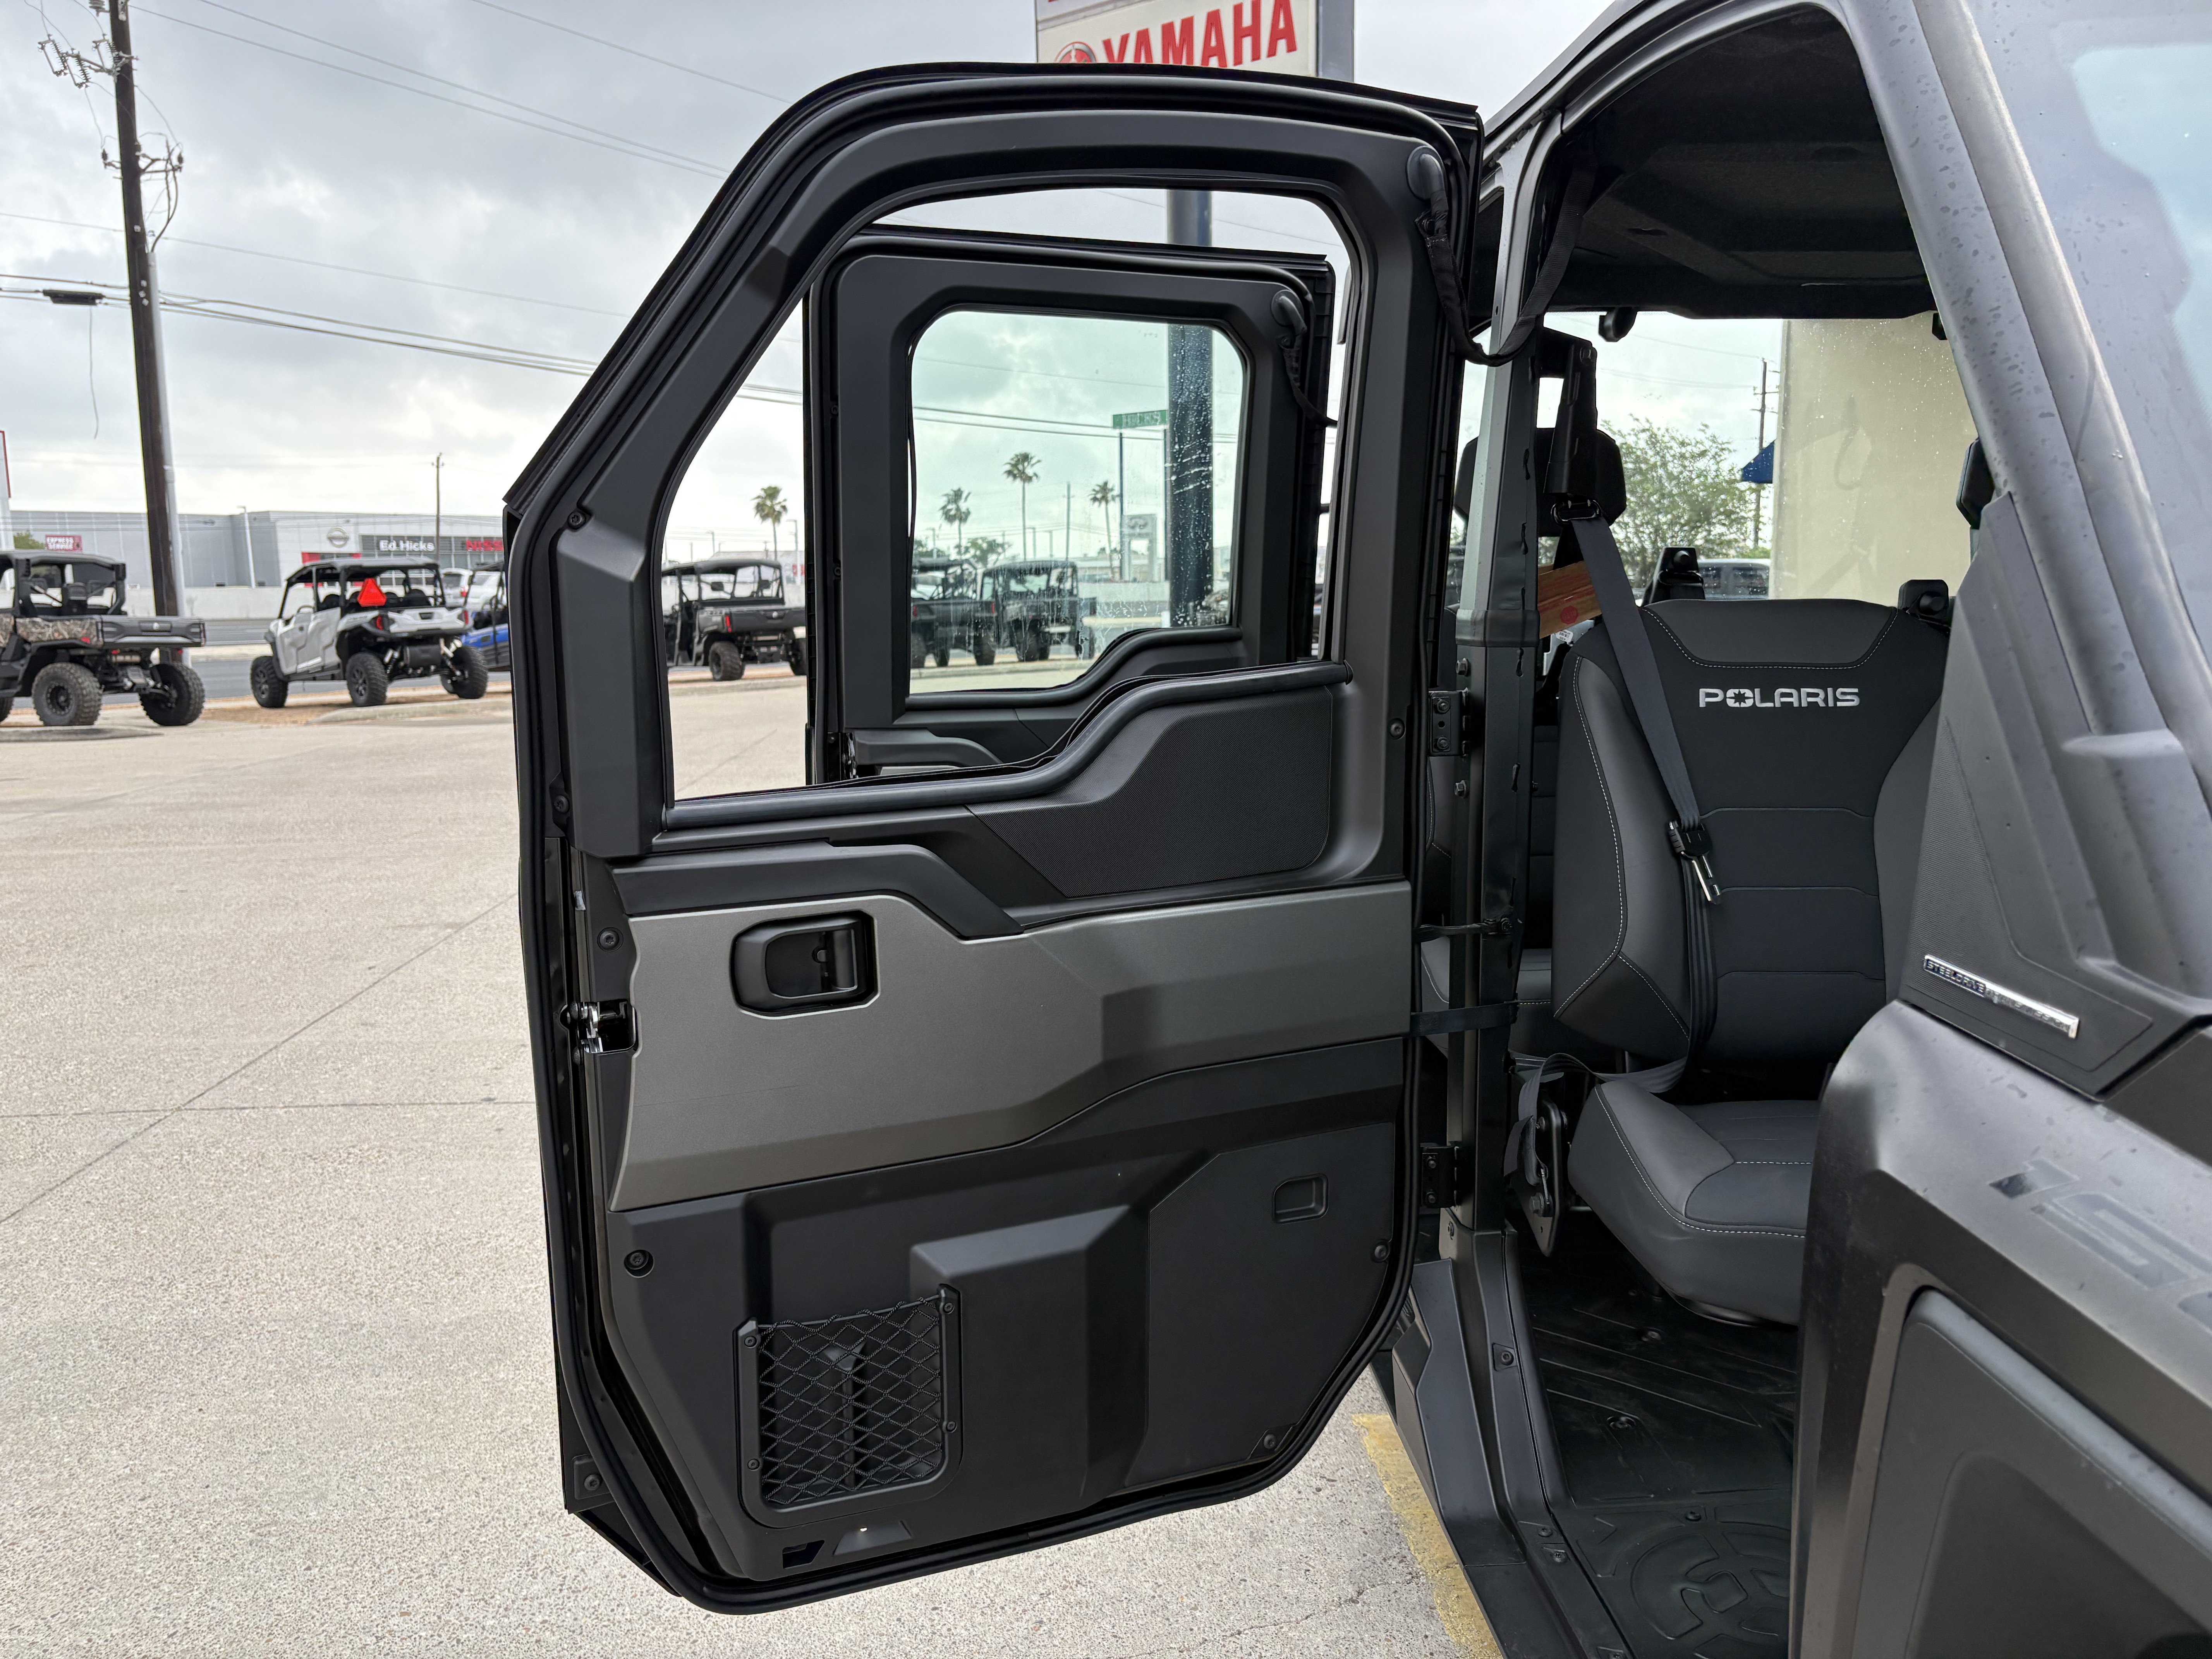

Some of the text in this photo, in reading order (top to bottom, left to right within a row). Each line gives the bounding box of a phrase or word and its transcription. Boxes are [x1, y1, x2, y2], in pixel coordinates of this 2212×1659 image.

[1102, 0, 1297, 67] YAMAHA
[380, 540, 397, 551] Ed
[400, 540, 435, 551] Hicks
[1699, 687, 1860, 708] POLARIS
[1989, 1156, 2212, 1332] 15
